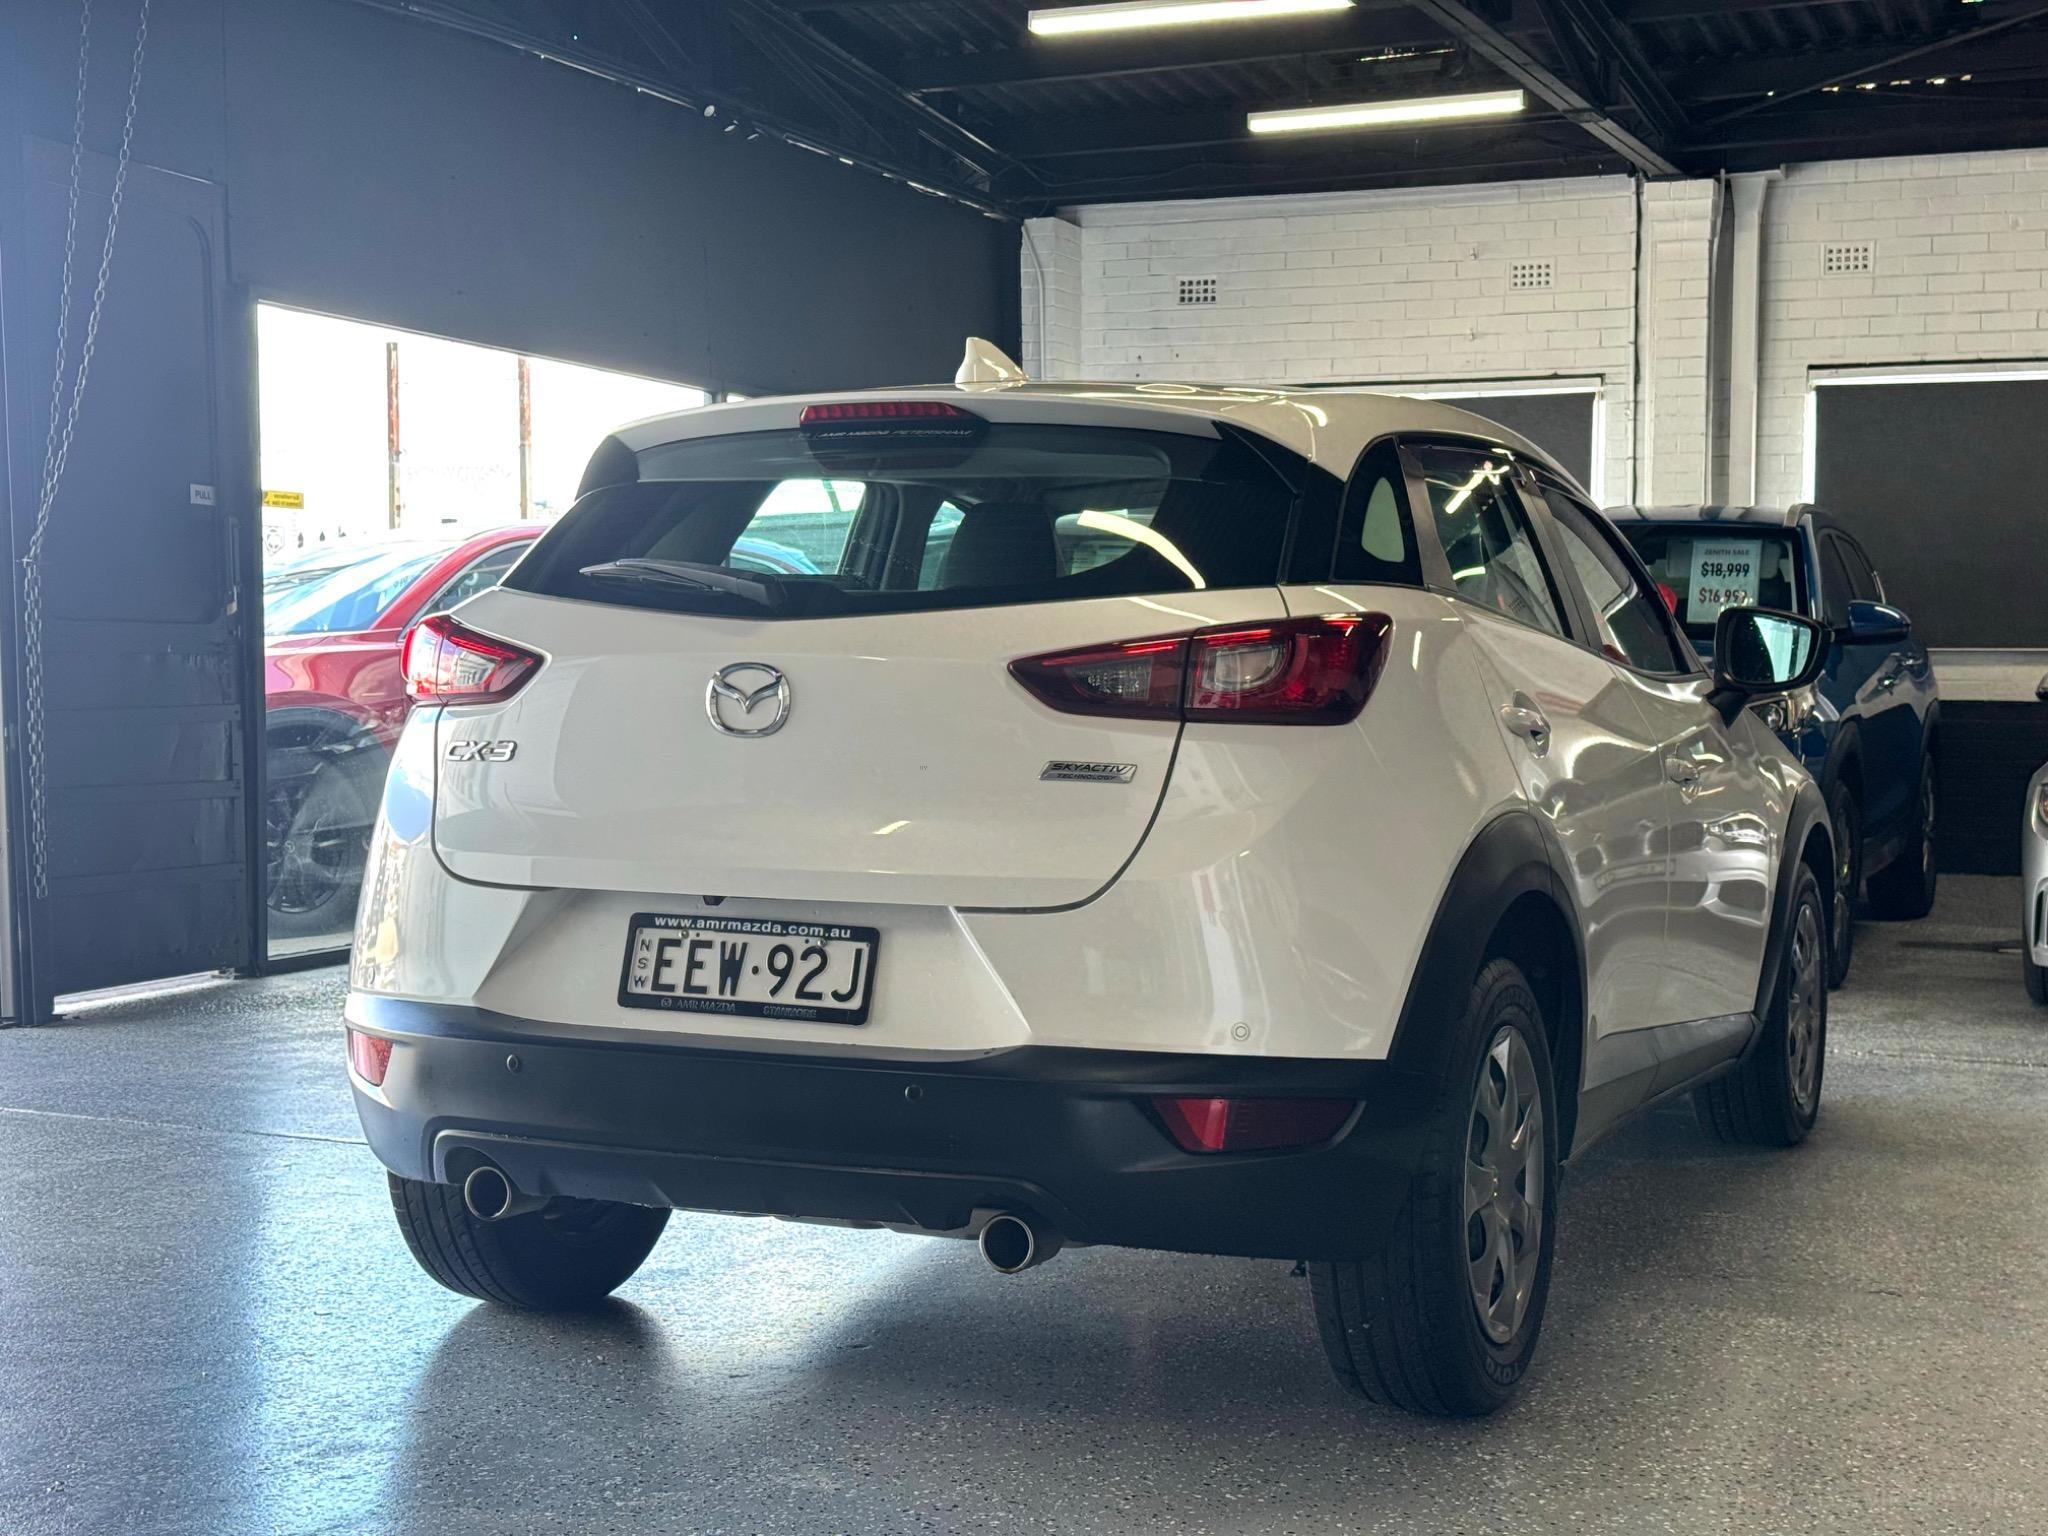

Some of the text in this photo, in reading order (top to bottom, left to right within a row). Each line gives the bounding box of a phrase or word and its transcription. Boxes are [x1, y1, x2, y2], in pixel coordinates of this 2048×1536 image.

[194, 489, 212, 500] PULL
[1701, 561, 1750, 579] $18,999
[446, 740, 518, 762] CX-3
[1050, 762, 1127, 774] SKYACTIV
[1056, 772, 1118, 781] TECHNOLOGY
[654, 916, 851, 939] www.amrmazda.com.au
[700, 1000, 736, 1013] MAZDA
